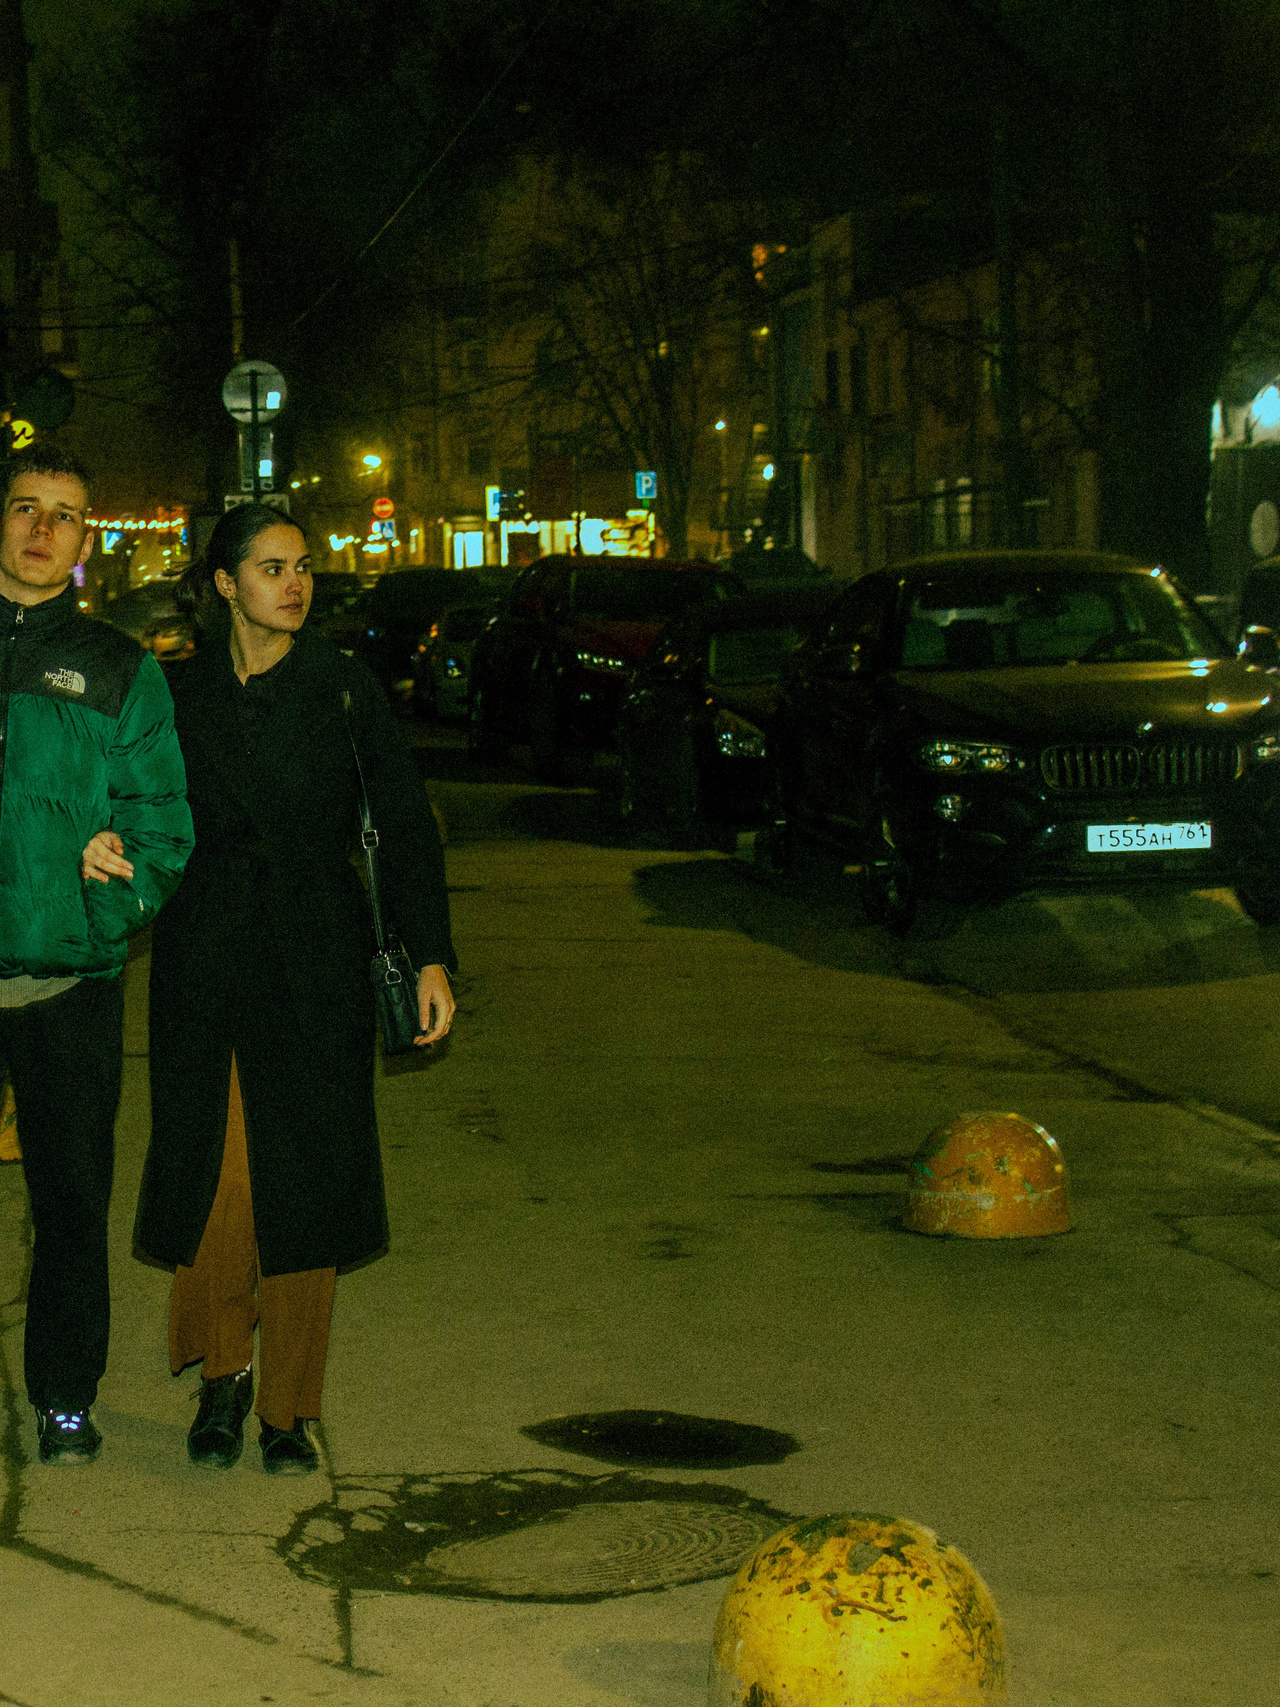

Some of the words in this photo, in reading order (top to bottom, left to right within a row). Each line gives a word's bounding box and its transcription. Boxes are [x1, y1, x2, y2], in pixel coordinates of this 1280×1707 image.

[44, 671, 73, 684] NORTH
[59, 667, 74, 677] THE
[52, 679, 72, 690] FACE
